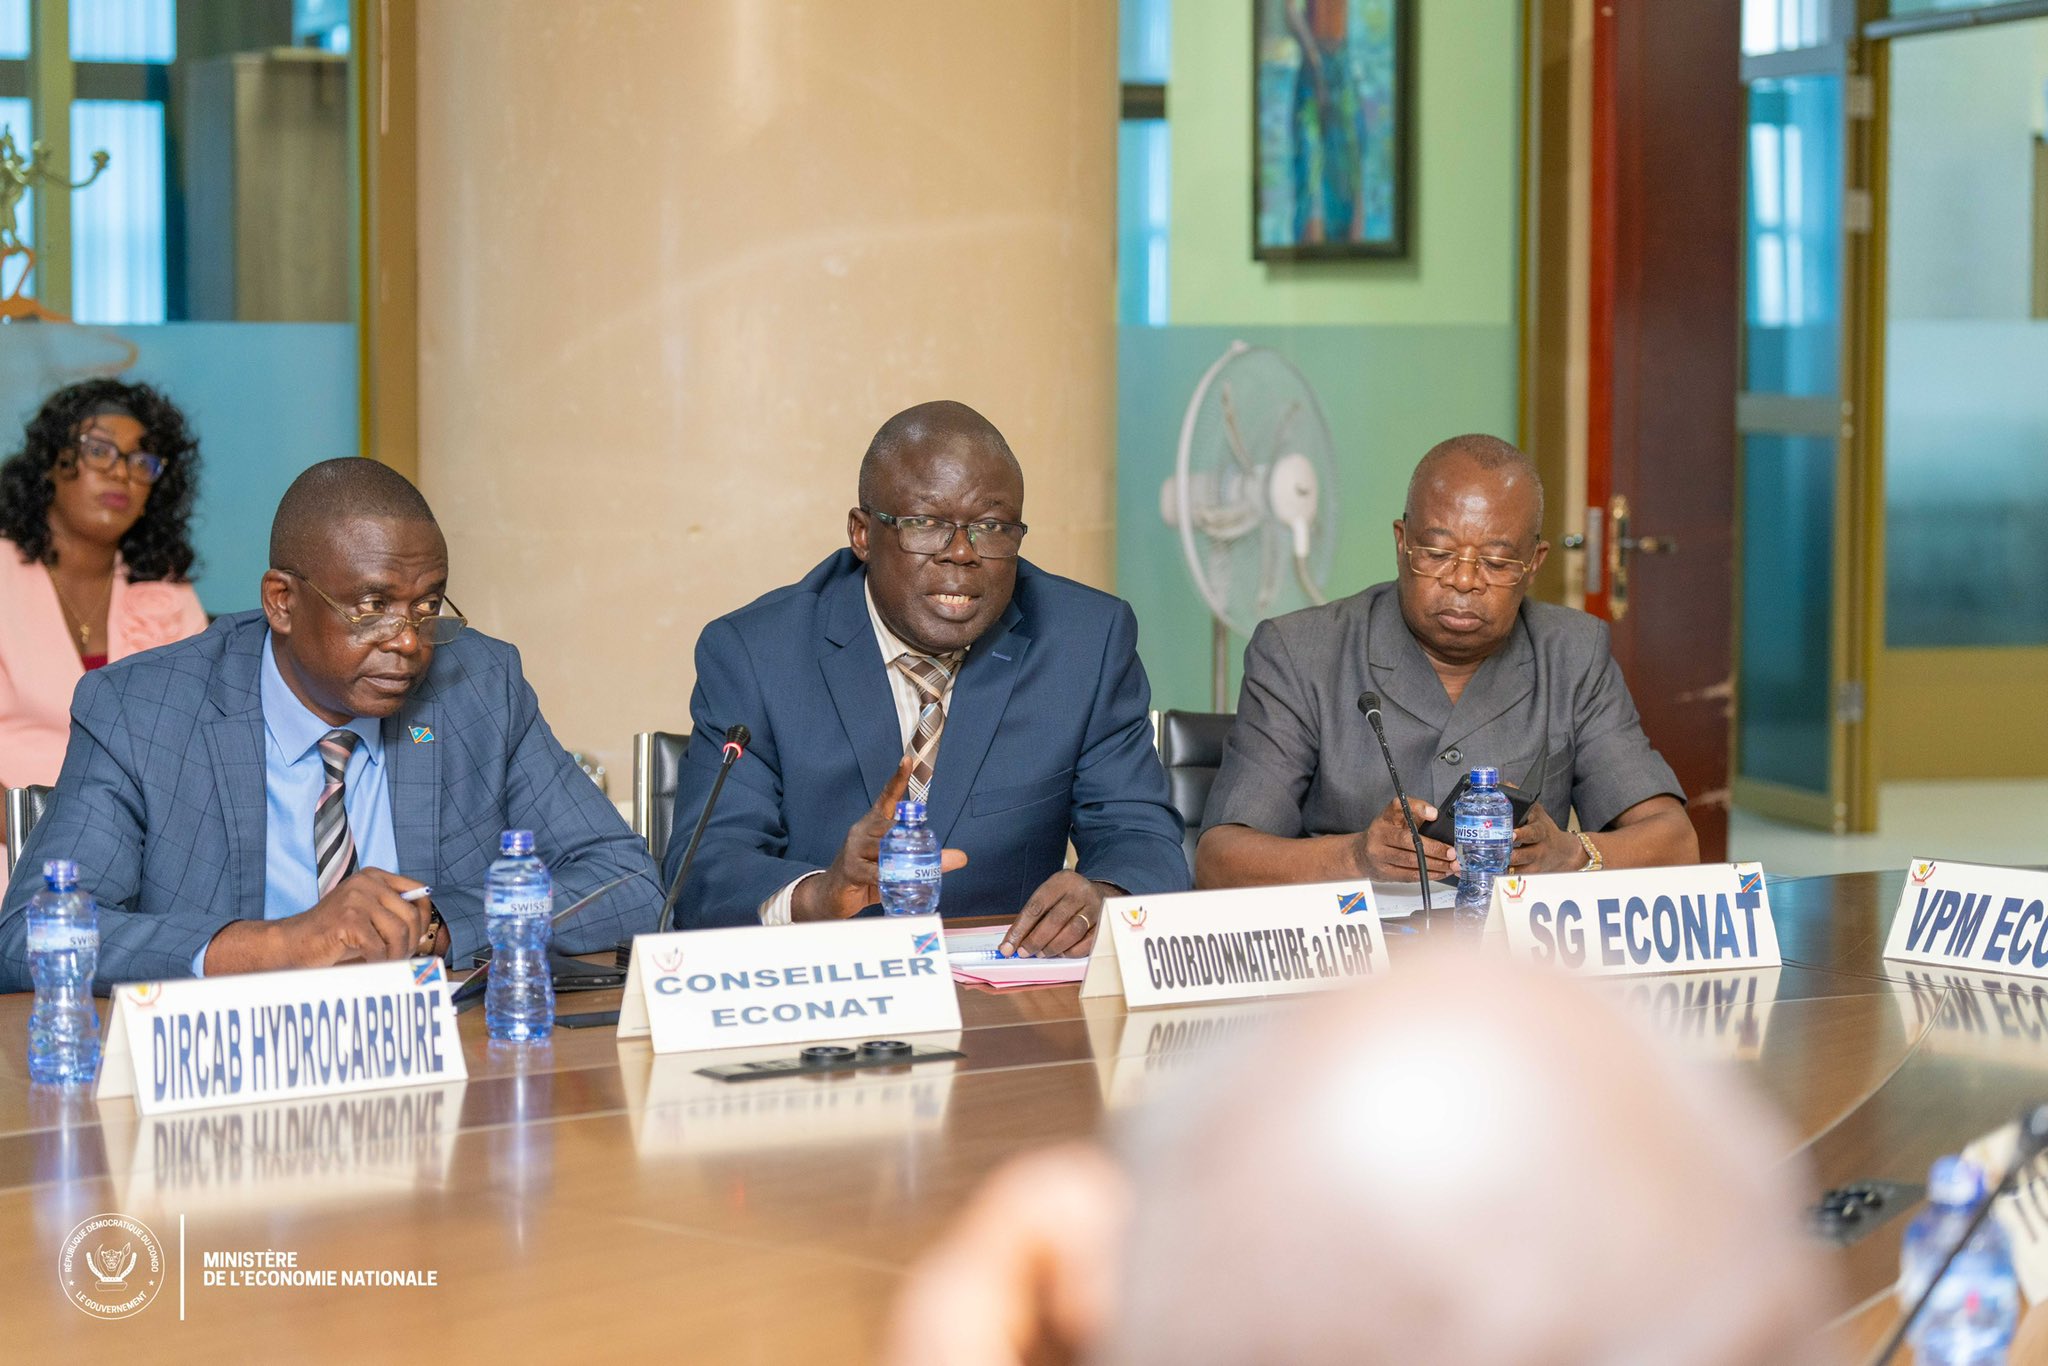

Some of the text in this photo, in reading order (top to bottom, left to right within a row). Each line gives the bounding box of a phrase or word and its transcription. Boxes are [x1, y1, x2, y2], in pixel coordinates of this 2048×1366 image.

[1144, 923, 1374, 990] COORDONNATEURE a.i CRP
[1529, 892, 1761, 969] SG ECONAT
[1905, 887, 1993, 959] VPM
[654, 956, 937, 996] CONSEILLER
[153, 989, 444, 1102] DIRCAB HYDROCARBURE
[712, 996, 895, 1028] ECONAT
